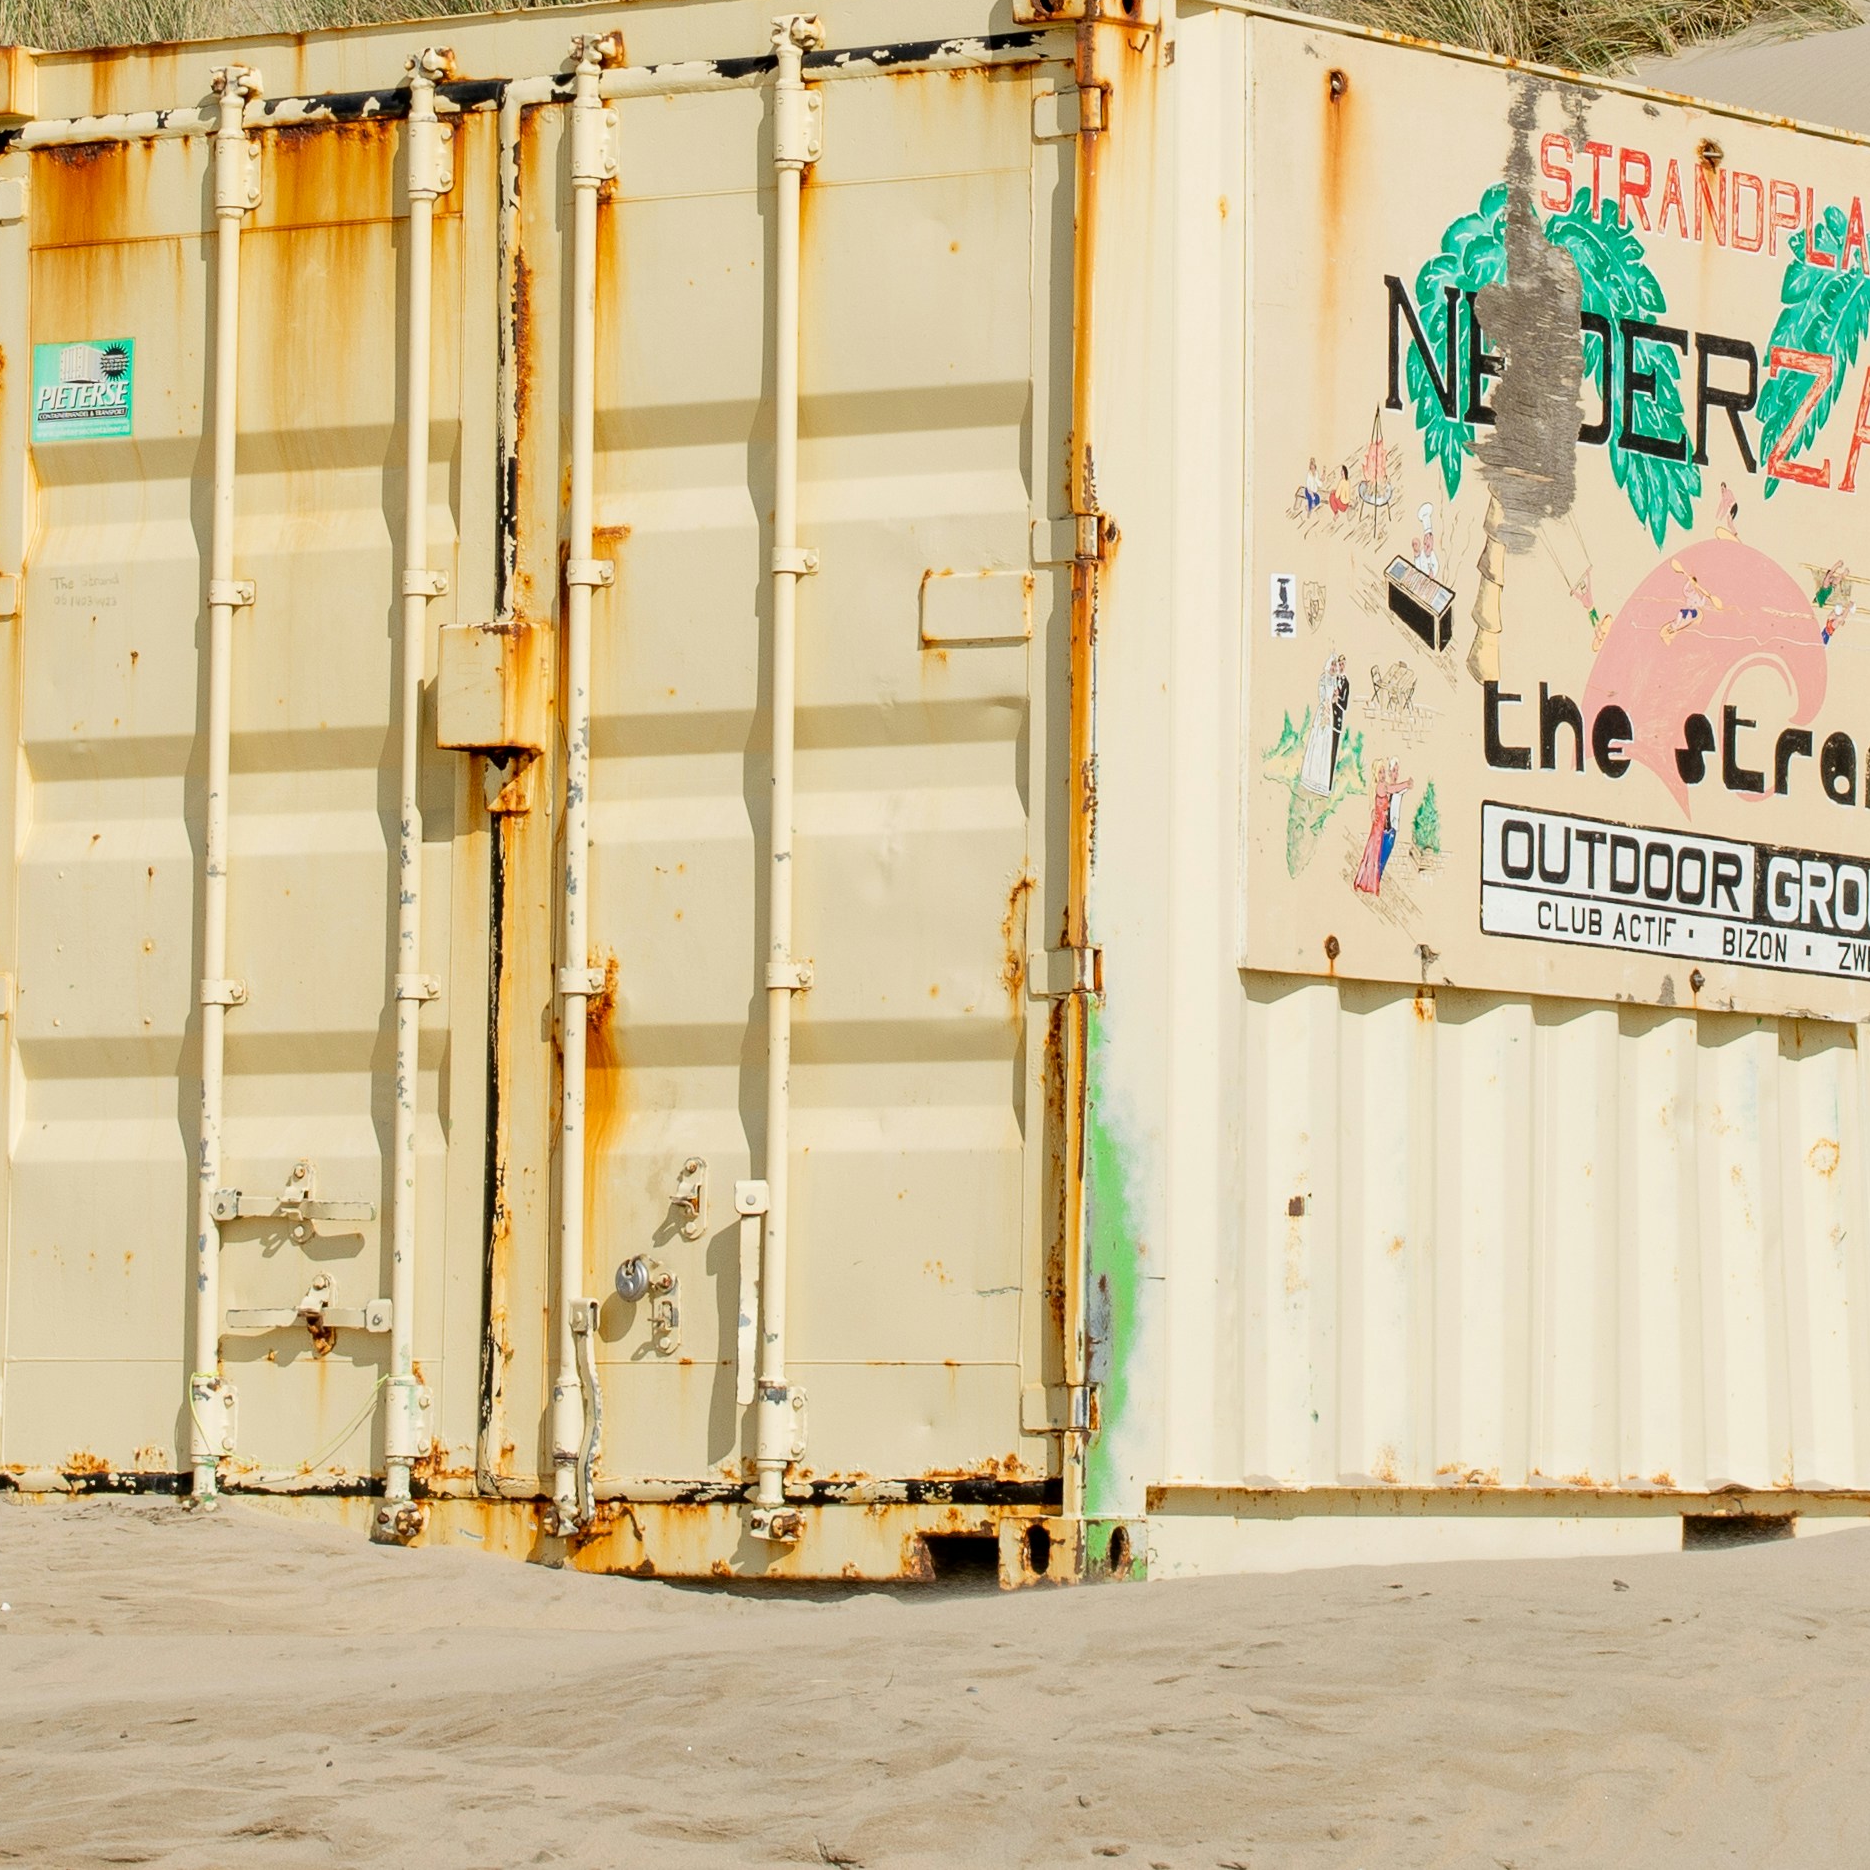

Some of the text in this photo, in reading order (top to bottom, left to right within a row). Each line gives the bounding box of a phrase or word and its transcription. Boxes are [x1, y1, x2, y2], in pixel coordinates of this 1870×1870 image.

[37, 381, 130, 411] PIETERSE
[49, 572, 119, 590] The Strand
[1484, 679, 1633, 779] the
[1501, 819, 1743, 913] OUTDOOR
[1537, 900, 1602, 936] CLUB
[1612, 912, 1677, 947] ACTIF
[1722, 926, 1788, 963] BIZON
